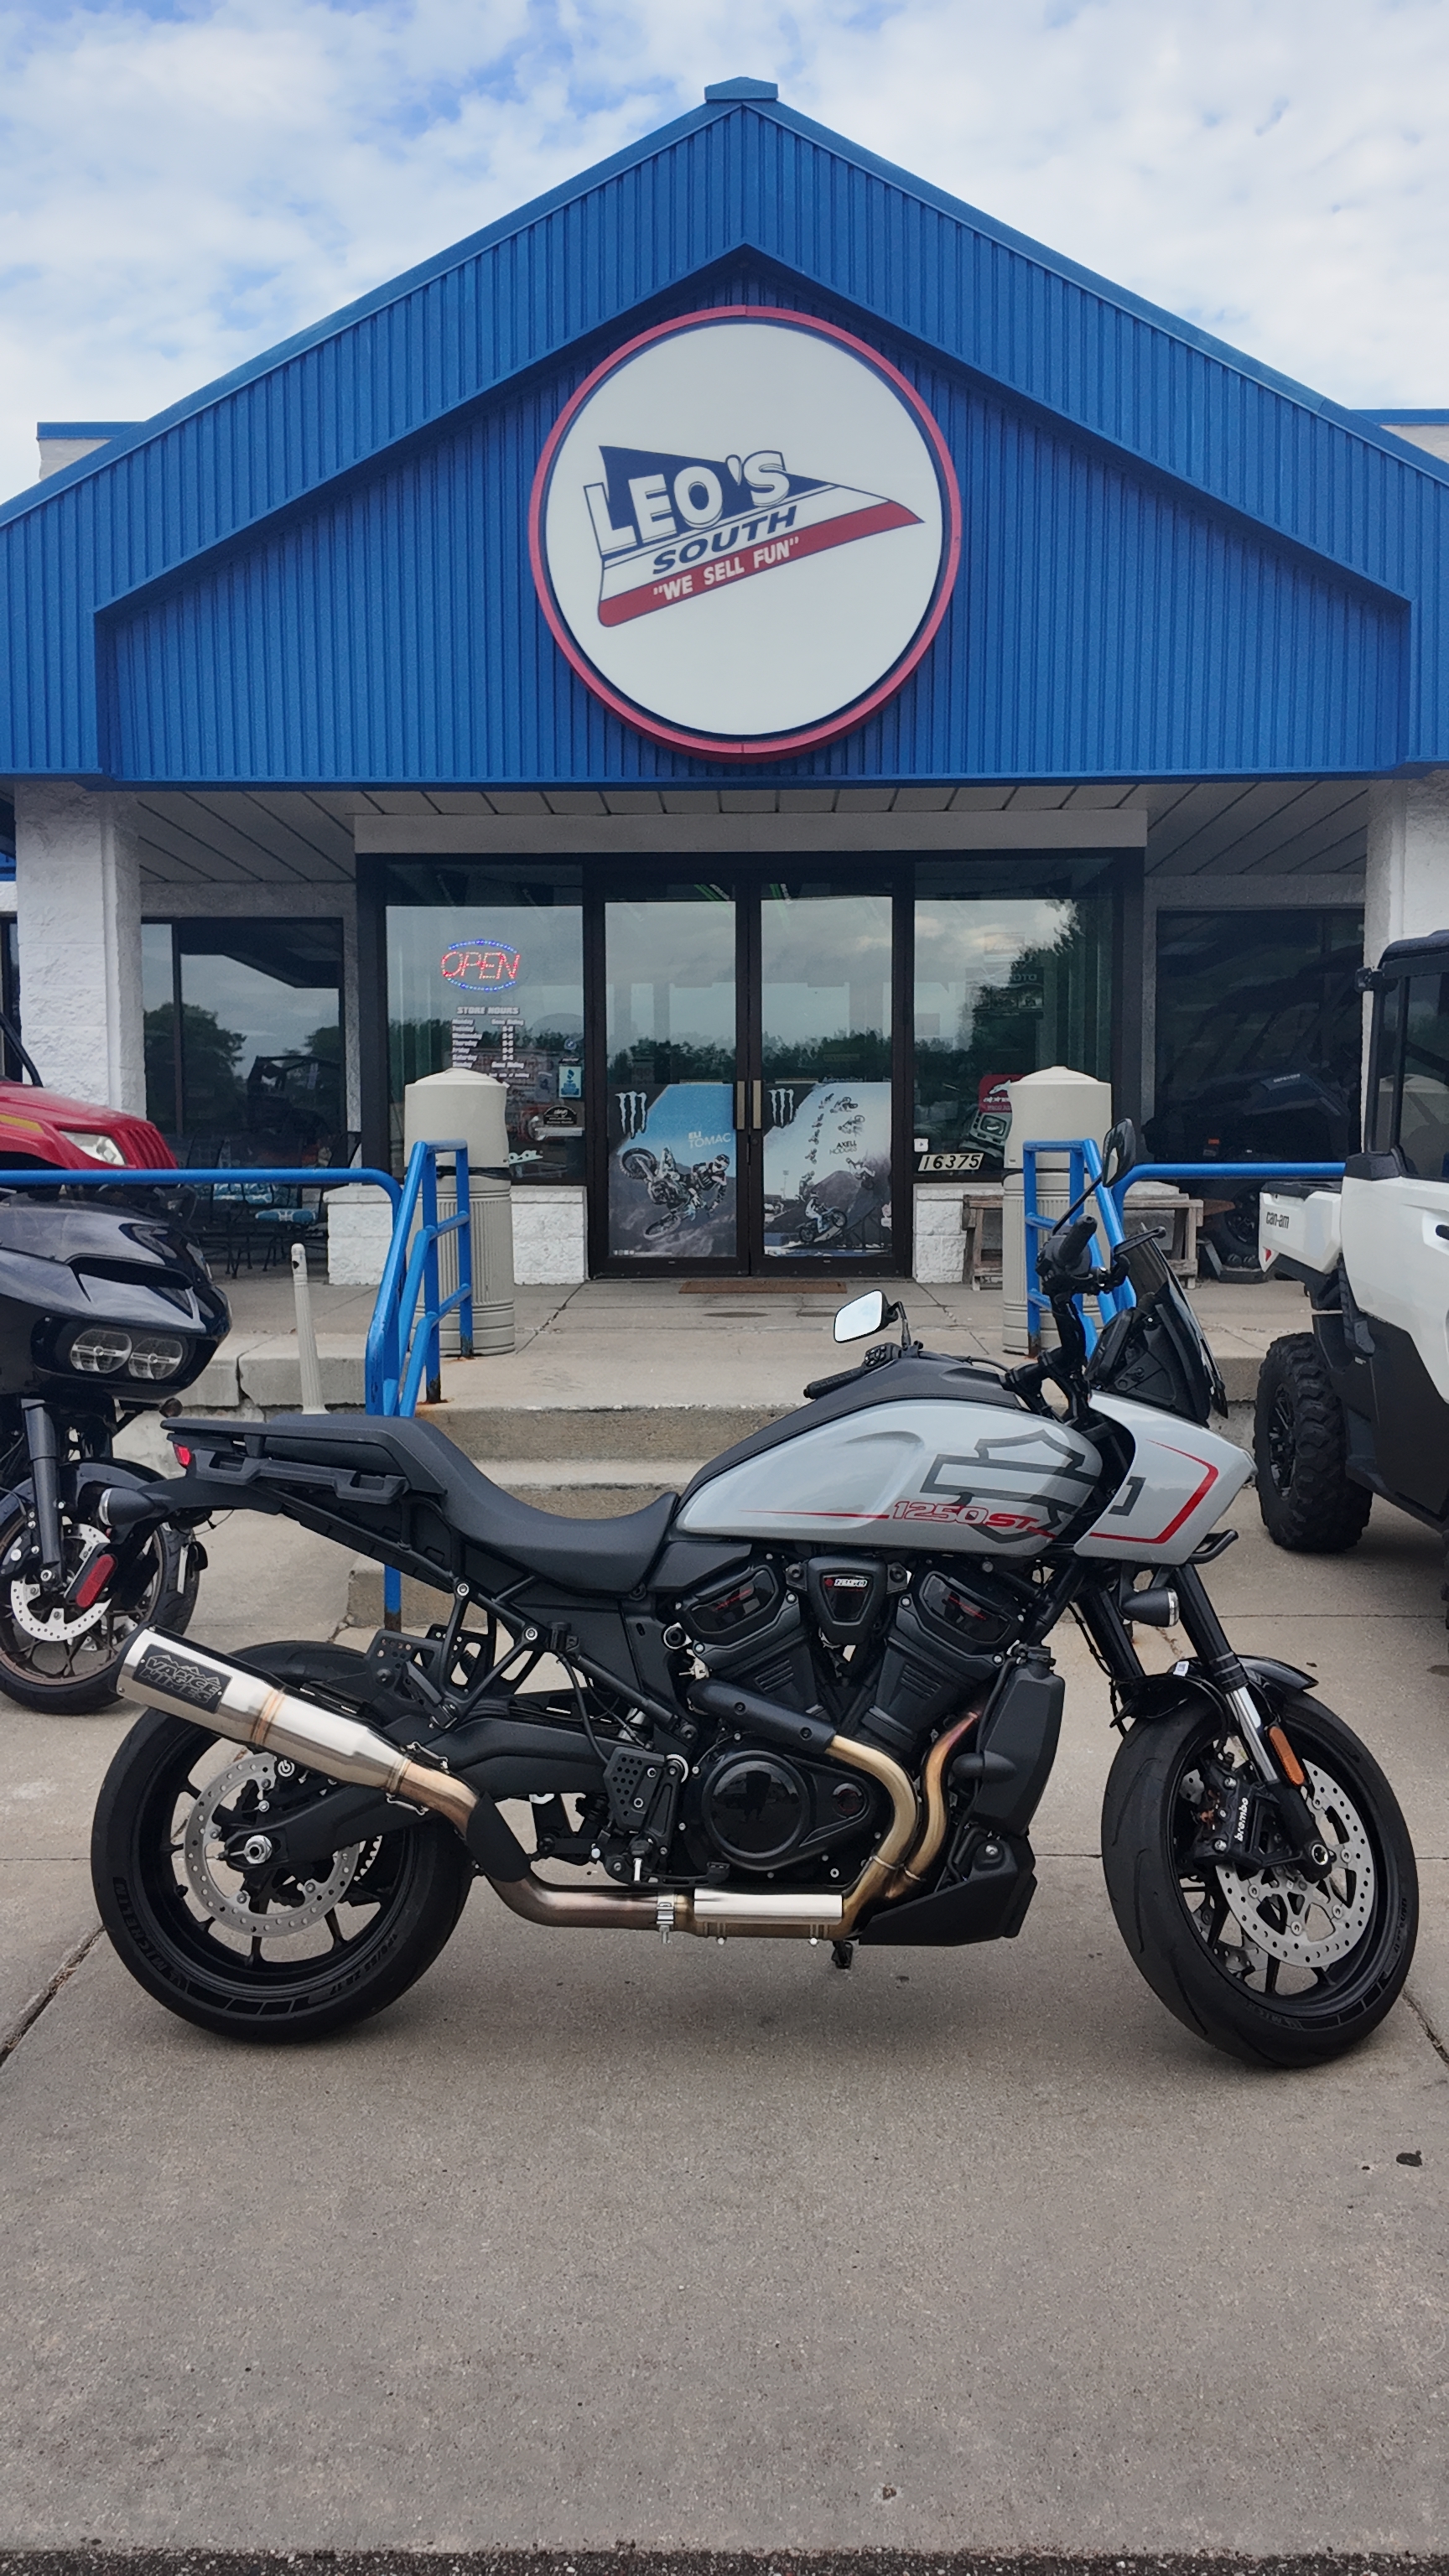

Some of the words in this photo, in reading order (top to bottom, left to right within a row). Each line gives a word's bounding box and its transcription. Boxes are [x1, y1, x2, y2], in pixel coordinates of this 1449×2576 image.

[583, 449, 790, 558] LEO'S
[652, 505, 797, 575] SOUTH
[653, 574, 693, 601] "WE
[704, 558, 745, 585] SELL
[753, 536, 800, 569] FUN"
[440, 951, 521, 979] OPEN
[456, 1006, 486, 1015] STORE
[487, 1006, 519, 1015] HOURS
[688, 1132, 732, 1150] TOMAC
[836, 1140, 857, 1150] AXELL
[923, 1154, 981, 1170] 16375
[1265, 1212, 1290, 1229] can-am
[139, 1667, 216, 1704] HINES
[145, 1655, 222, 1696] VANCE
[1233, 1797, 1249, 1842] brembo
[114, 1882, 169, 1972] MICHELIN
